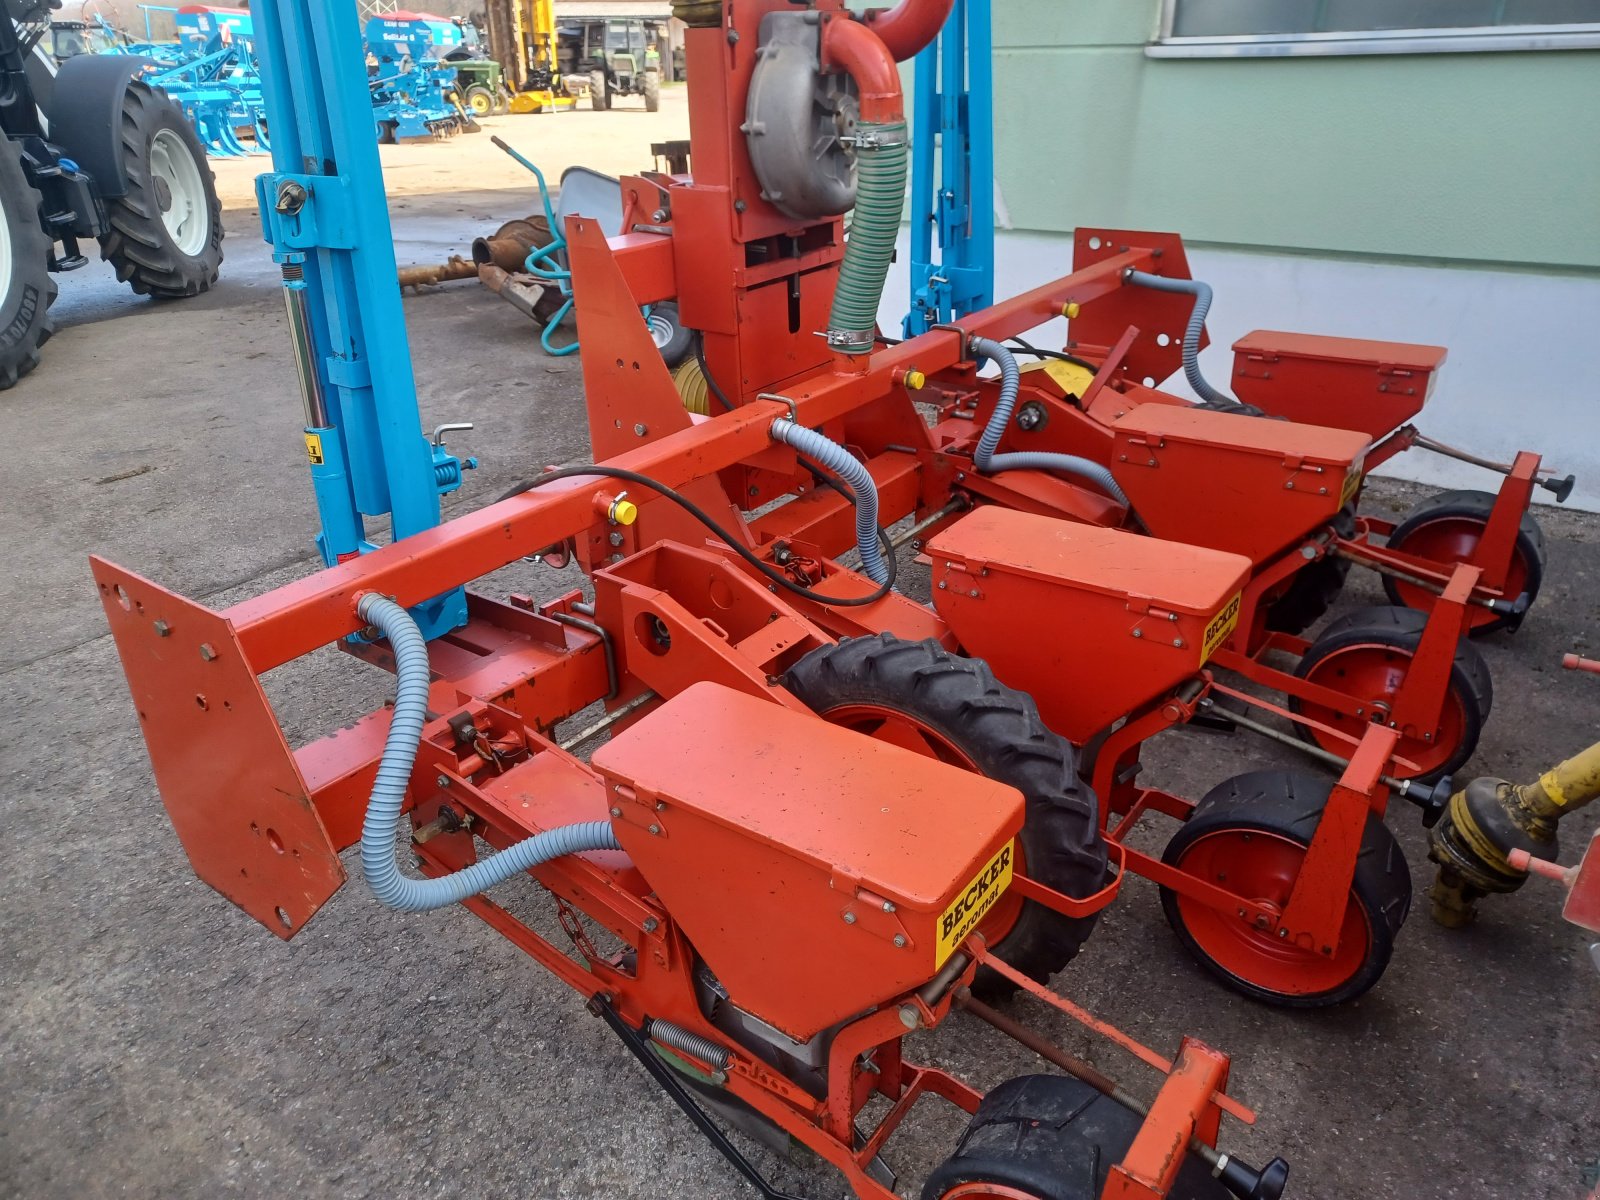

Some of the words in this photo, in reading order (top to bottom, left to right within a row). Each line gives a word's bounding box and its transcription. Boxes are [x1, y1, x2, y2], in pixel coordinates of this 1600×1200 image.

[1204, 597, 1239, 647] BECKER
[942, 846, 1010, 941] BECKER
[951, 884, 1000, 947] aeromat
